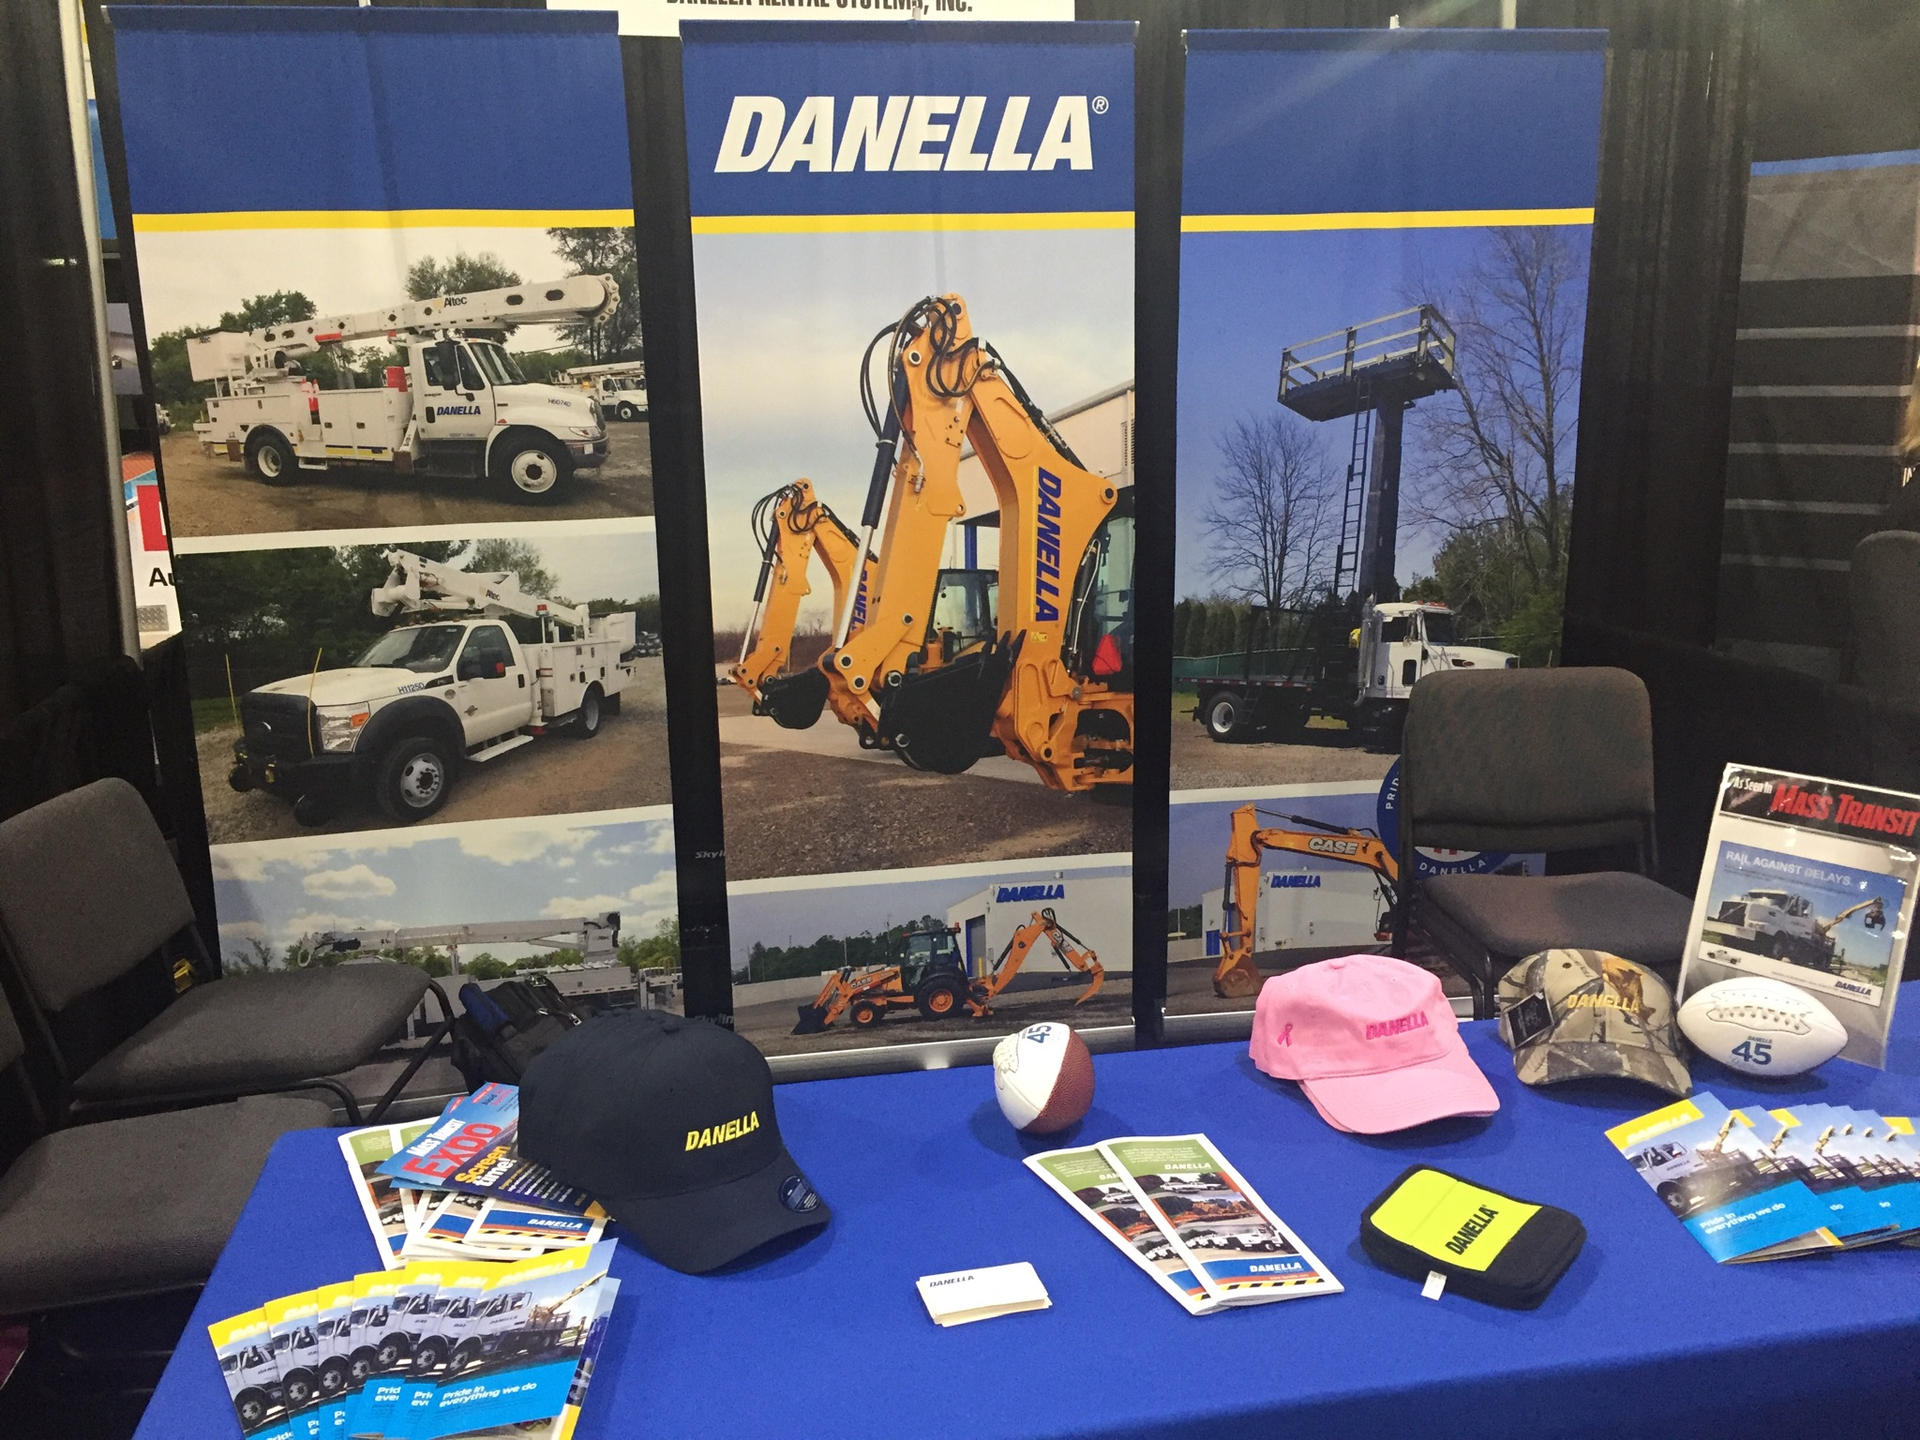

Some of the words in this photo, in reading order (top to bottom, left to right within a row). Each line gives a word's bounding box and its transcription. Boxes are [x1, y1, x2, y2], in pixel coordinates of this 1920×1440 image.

[444, 296, 467, 308] Altec
[436, 406, 481, 416] DANELLA
[1035, 467, 1062, 622] DANELLA
[1308, 837, 1358, 855] CASE
[1726, 850, 1750, 865] RAIL
[1752, 859, 1803, 875] AGAINST
[1271, 875, 1321, 888] DANELLA
[996, 884, 1065, 903] DANELLA
[1834, 981, 1872, 996] DANELLA
[1566, 993, 1640, 1013] DANELLA
[1026, 1025, 1052, 1043] 45
[1366, 1011, 1429, 1041] DANELLA
[1731, 1041, 1772, 1065] 45
[685, 1111, 760, 1151] DANELLA
[401, 1122, 502, 1179] EXPO
[455, 1144, 511, 1184] Screen
[472, 1157, 517, 1187] time!
[1164, 1162, 1212, 1170] DANELLA
[527, 1218, 583, 1229] DANELLA
[1700, 1217, 1725, 1229] Pride
[1705, 1212, 1757, 1235] everything
[1756, 1208, 1772, 1216] we
[1771, 1202, 1786, 1211] do
[1249, 1262, 1302, 1272] DANELLA
[930, 1275, 974, 1287] DANELLA
[439, 1390, 500, 1407] everything
[503, 1386, 520, 1394] we
[522, 1383, 537, 1391] do
[443, 1388, 472, 1400] Pride
